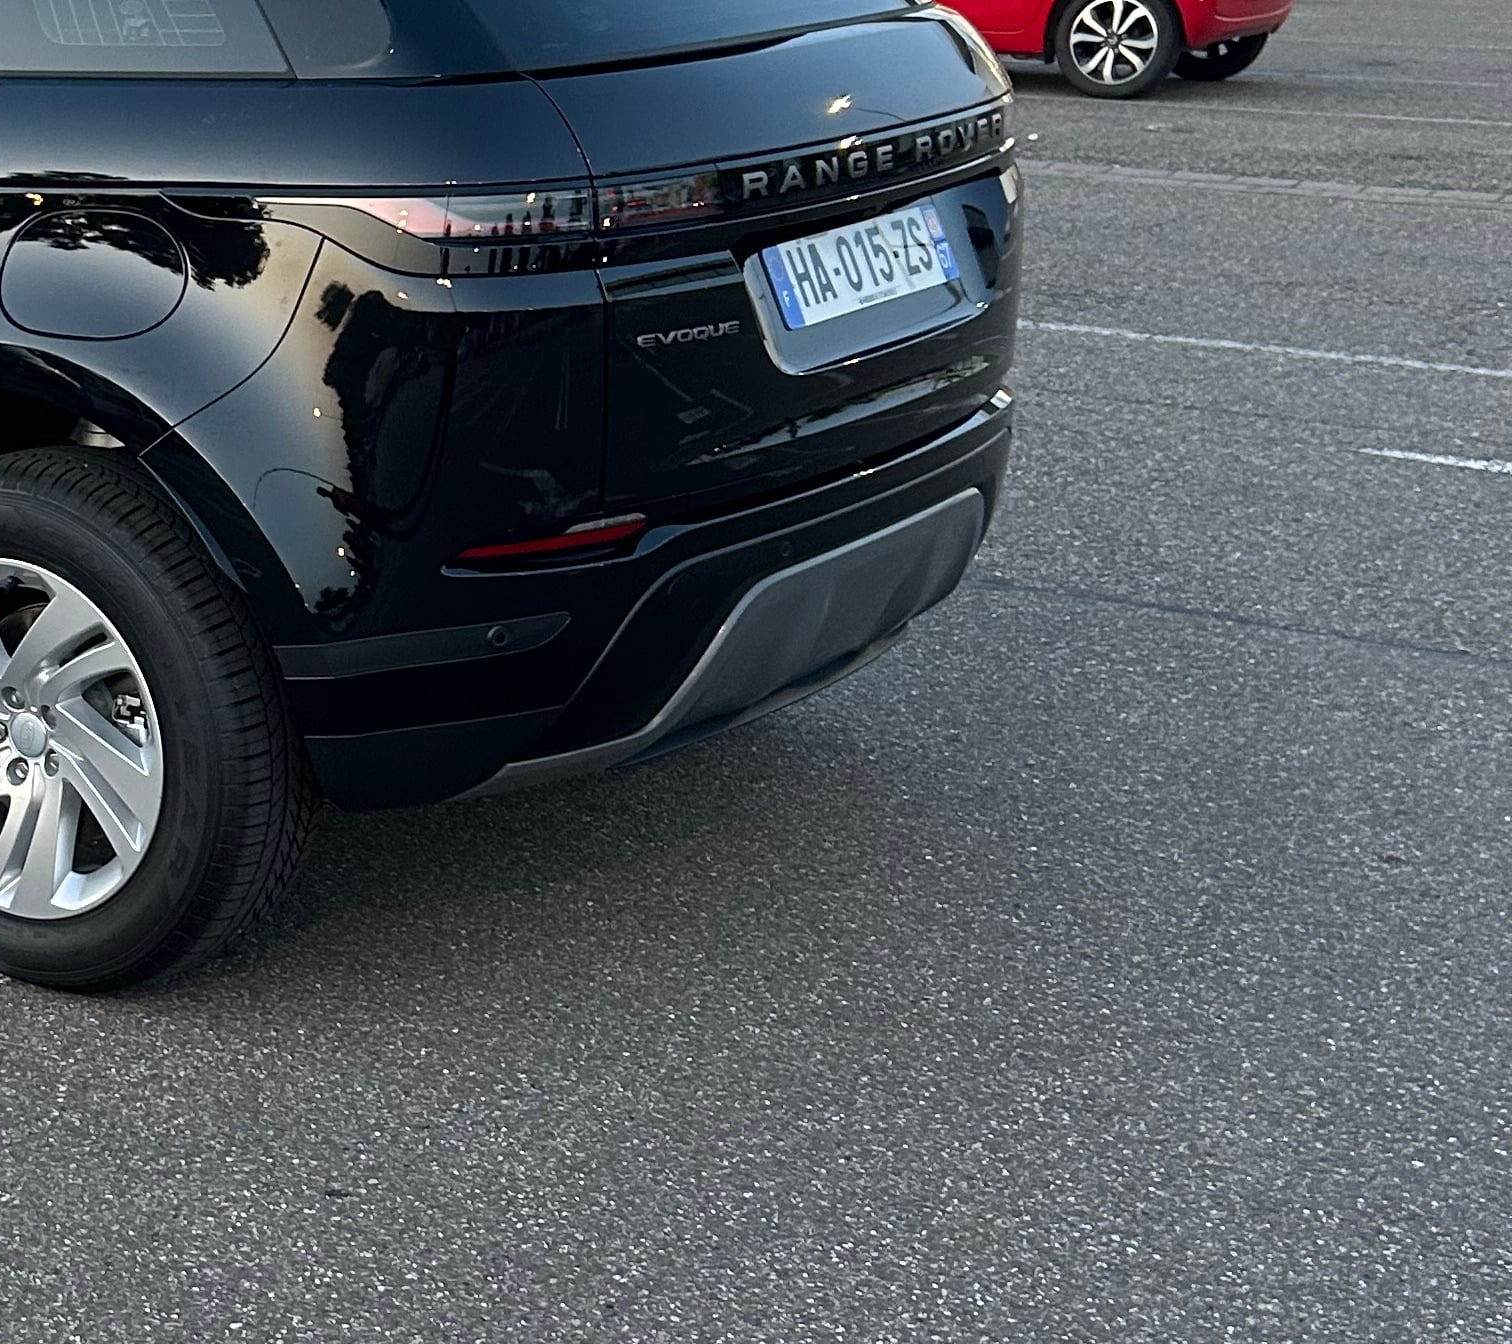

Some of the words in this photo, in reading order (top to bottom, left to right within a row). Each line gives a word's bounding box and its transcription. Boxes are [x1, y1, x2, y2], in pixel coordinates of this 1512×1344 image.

[742, 144, 894, 200] RANGE
[786, 217, 934, 308] HA-015-ZS
[936, 242, 952, 269] 67
[637, 320, 740, 348] EVOQUE
